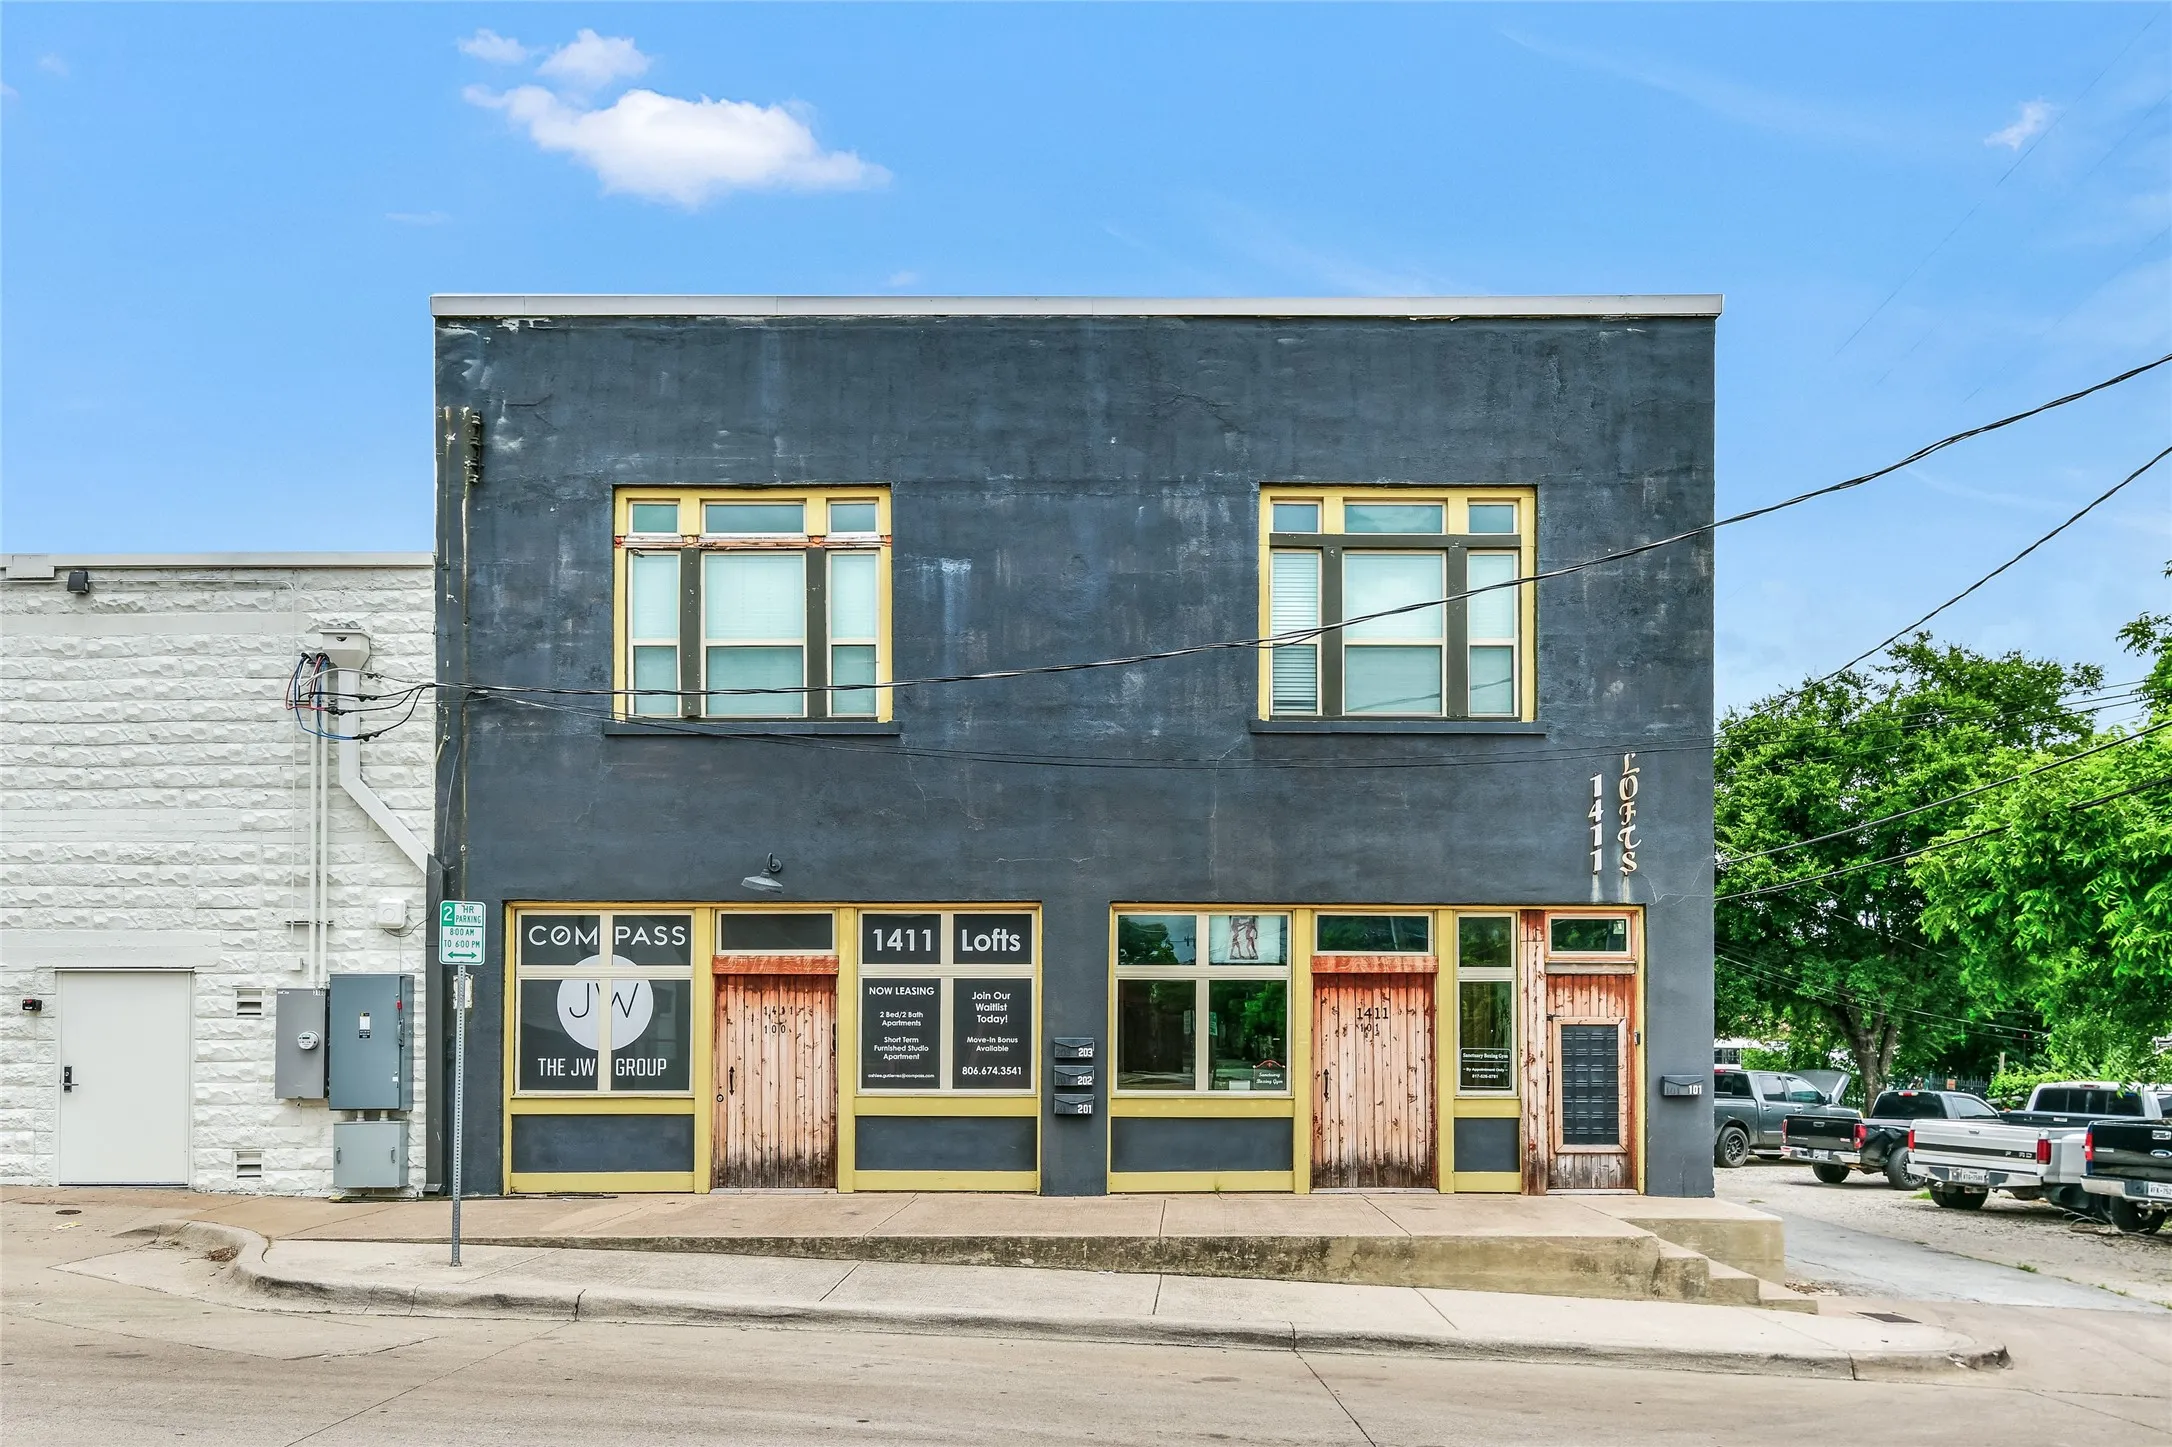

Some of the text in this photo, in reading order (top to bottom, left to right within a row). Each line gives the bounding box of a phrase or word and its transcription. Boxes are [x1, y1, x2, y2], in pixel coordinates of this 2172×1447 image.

[1617, 752, 1642, 875] LOFTS
[1587, 773, 1604, 873] 1411
[443, 905, 475, 921] 2 HR
[455, 915, 482, 924] PARKING
[444, 940, 452, 948] TO
[471, 941, 481, 949] PM
[872, 927, 1021, 952] 1411 Lofts
[869, 986, 935, 996] NOW LEASING
[971, 991, 1011, 1000] Join Our
[569, 982, 639, 1019] JW
[975, 1003, 1008, 1012] Waitlist
[1357, 1007, 1389, 1020] 1411
[881, 1019, 922, 1028] Apartments
[976, 1014, 1008, 1025] Today!
[764, 1024, 787, 1034] 100
[873, 1044, 930, 1052] Furnished Studio
[1078, 1047, 1094, 1058] 203
[883, 1053, 920, 1061] Apartment
[537, 1058, 667, 1077] THE JW GROUP
[962, 1066, 1022, 1076] 806.674.3541
[1077, 1075, 1093, 1086] 202
[1688, 1084, 1702, 1095] 101
[1077, 1104, 1092, 1114] 201
